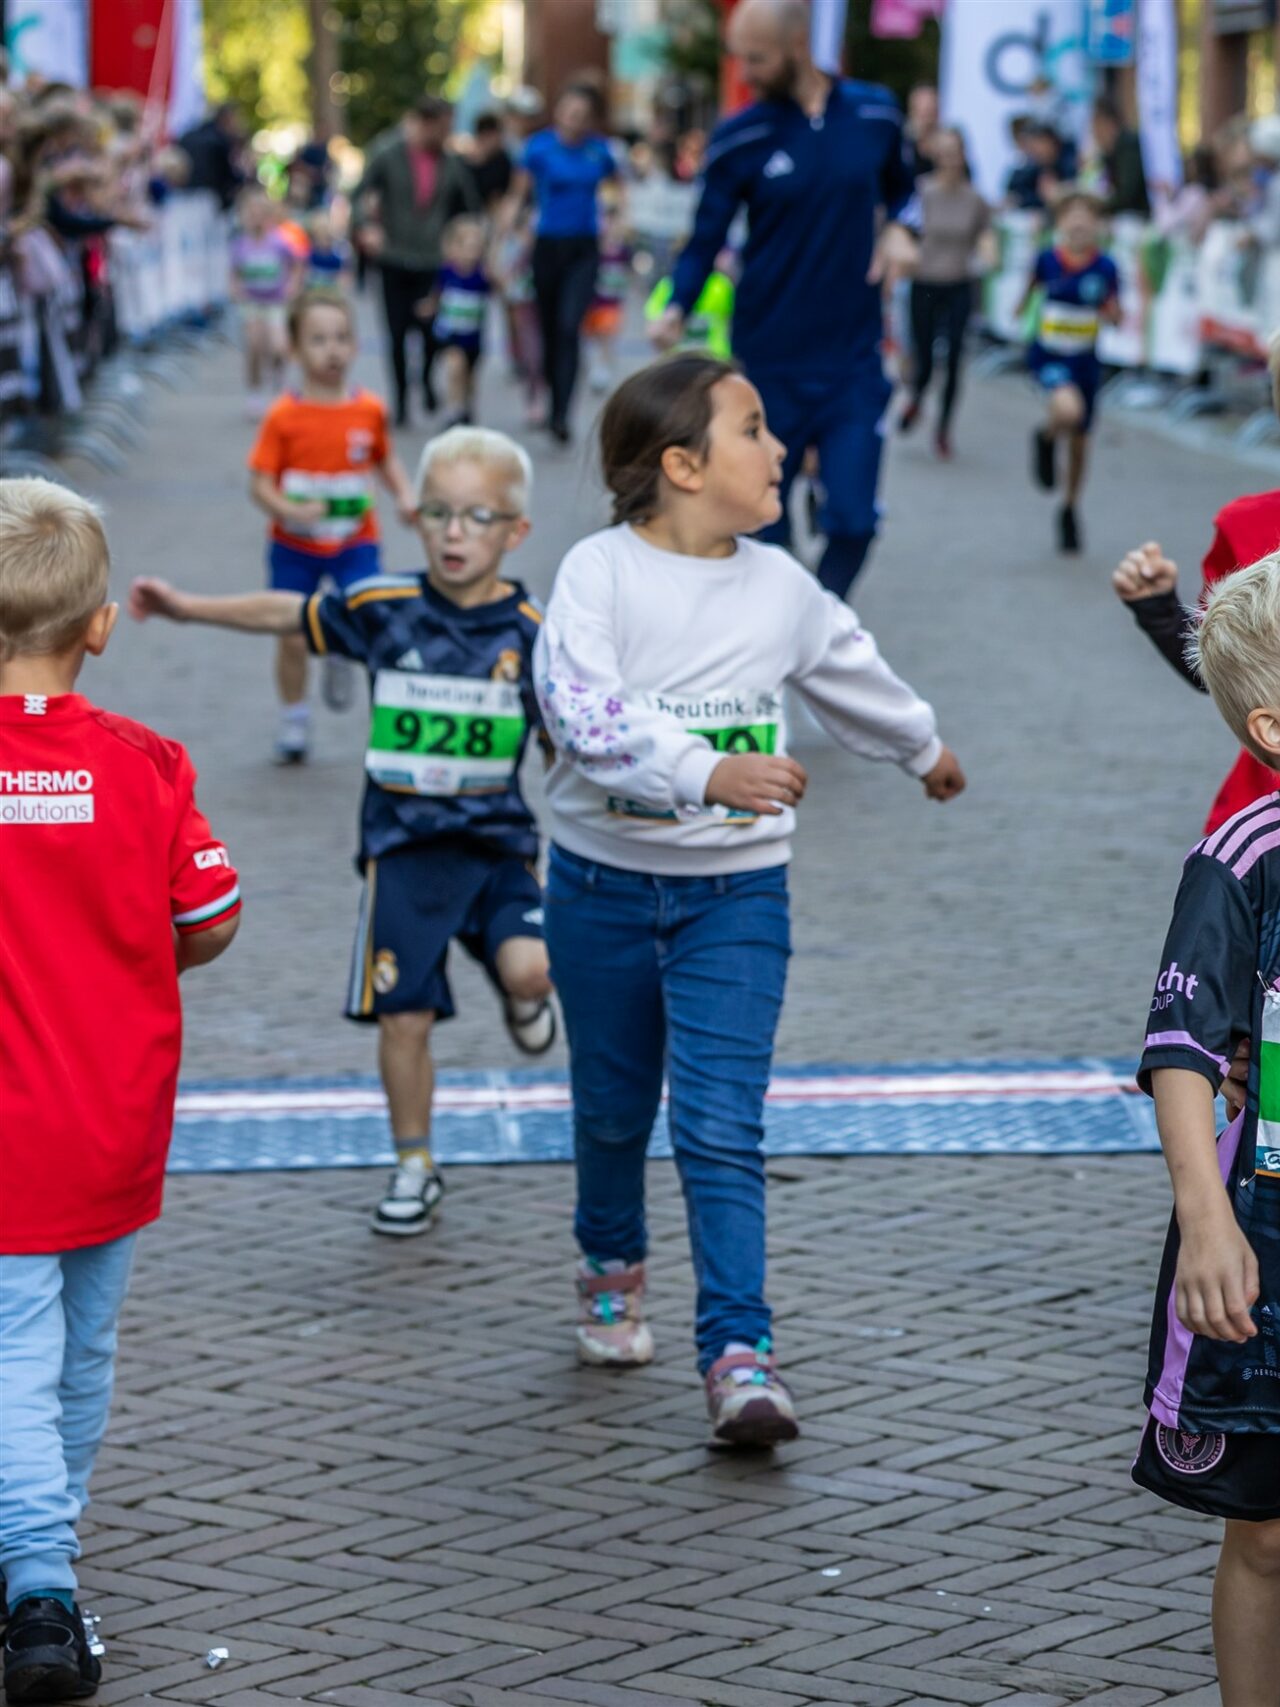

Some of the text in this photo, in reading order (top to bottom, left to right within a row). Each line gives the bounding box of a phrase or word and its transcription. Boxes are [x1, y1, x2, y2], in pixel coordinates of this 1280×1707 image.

[394, 709, 494, 758] 928
[0, 770, 93, 792] THERMO
[0, 799, 89, 821] olutions
[1157, 961, 1199, 1000] cht
